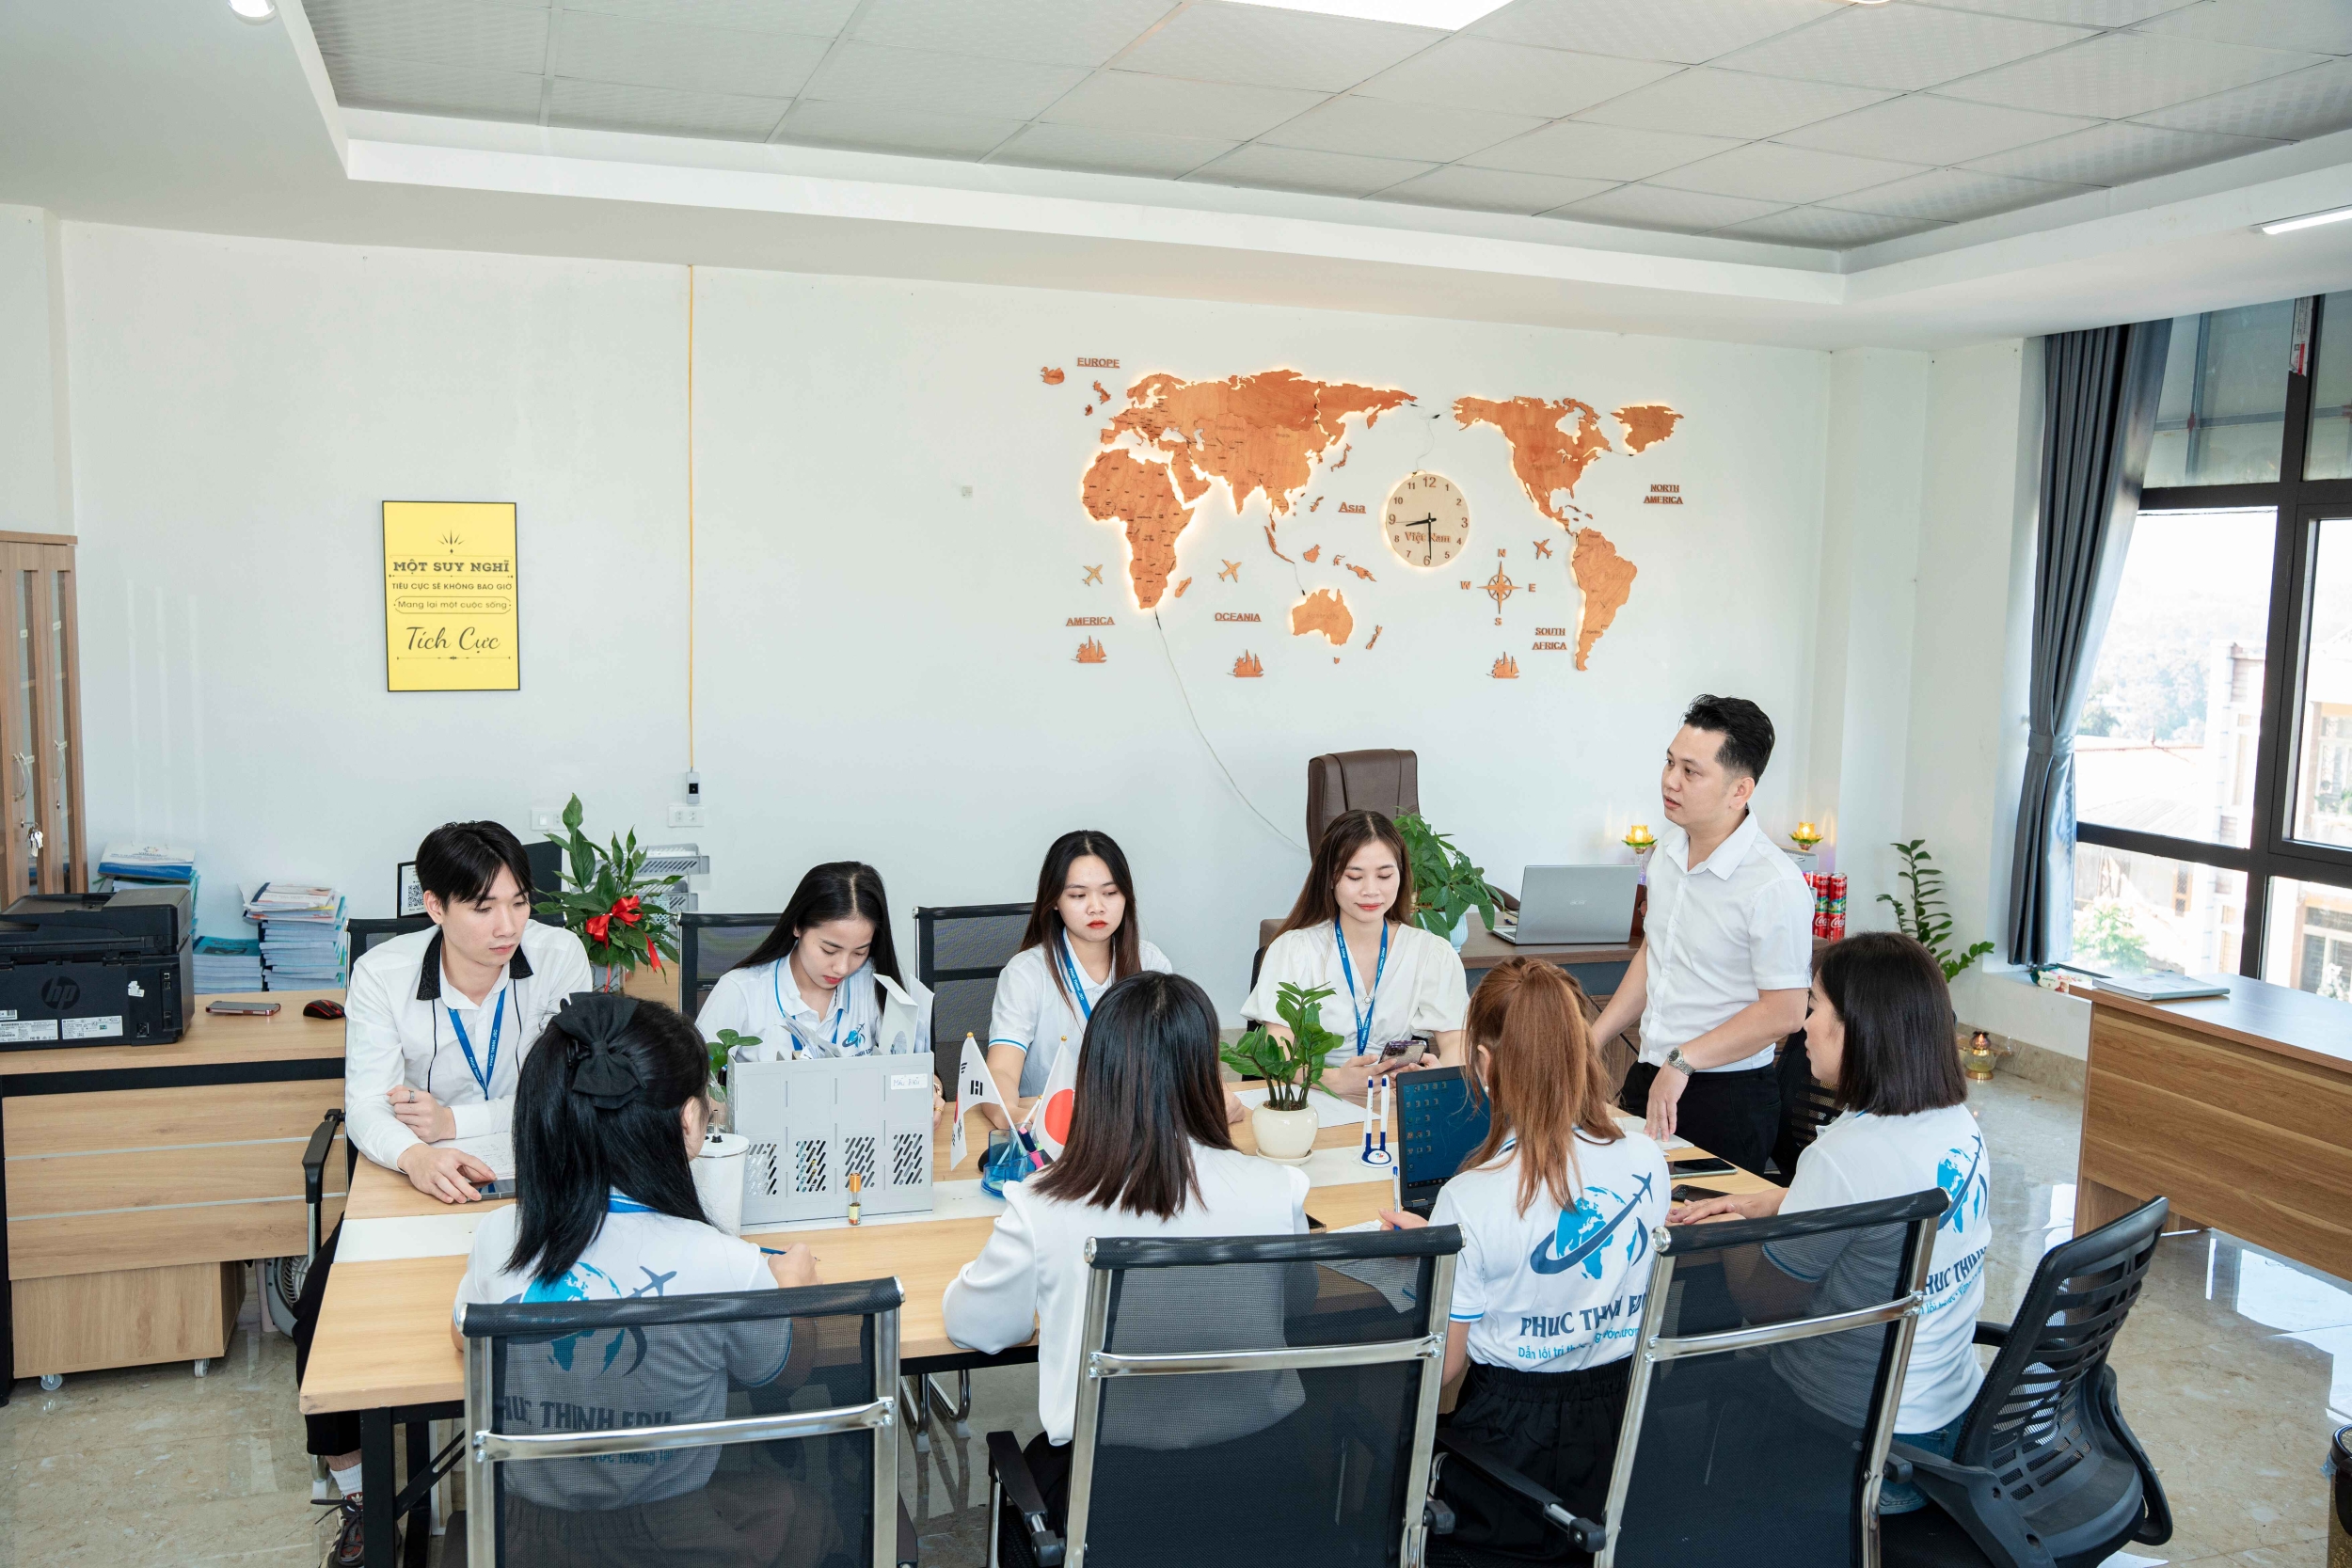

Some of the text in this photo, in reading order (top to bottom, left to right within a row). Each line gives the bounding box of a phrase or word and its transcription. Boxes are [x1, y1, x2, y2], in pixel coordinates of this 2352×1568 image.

[1076, 357, 1120, 368] EUROPE
[1423, 477, 1436, 487] 12
[1650, 483, 1680, 493] NORTH
[1644, 495, 1683, 504] AMERICA
[1389, 514, 1396, 525] 9
[1461, 517, 1469, 528] 3
[1405, 531, 1426, 544] Việt
[1498, 549, 1506, 558] N
[1423, 555, 1431, 566] 6
[393, 559, 509, 574] MỘT SUY NGHĨ
[411, 582, 430, 591] CỰC
[1460, 581, 1471, 590] W
[1528, 583, 1535, 593] E
[398, 601, 424, 610] Mang
[440, 601, 457, 610] một
[485, 601, 507, 610] sống
[1066, 616, 1116, 626] AMERICA
[1215, 612, 1261, 623] OCEANIA
[1494, 617, 1502, 626] S
[1535, 626, 1565, 636] SOUTH
[406, 626, 501, 654] Tích Cực
[1532, 641, 1567, 650] AFRICA
[45, 976, 77, 1010] hp
[1519, 1311, 1575, 1338] PHUC
[1518, 1345, 1535, 1359] Dẫn
[1538, 1348, 1550, 1358] lối
